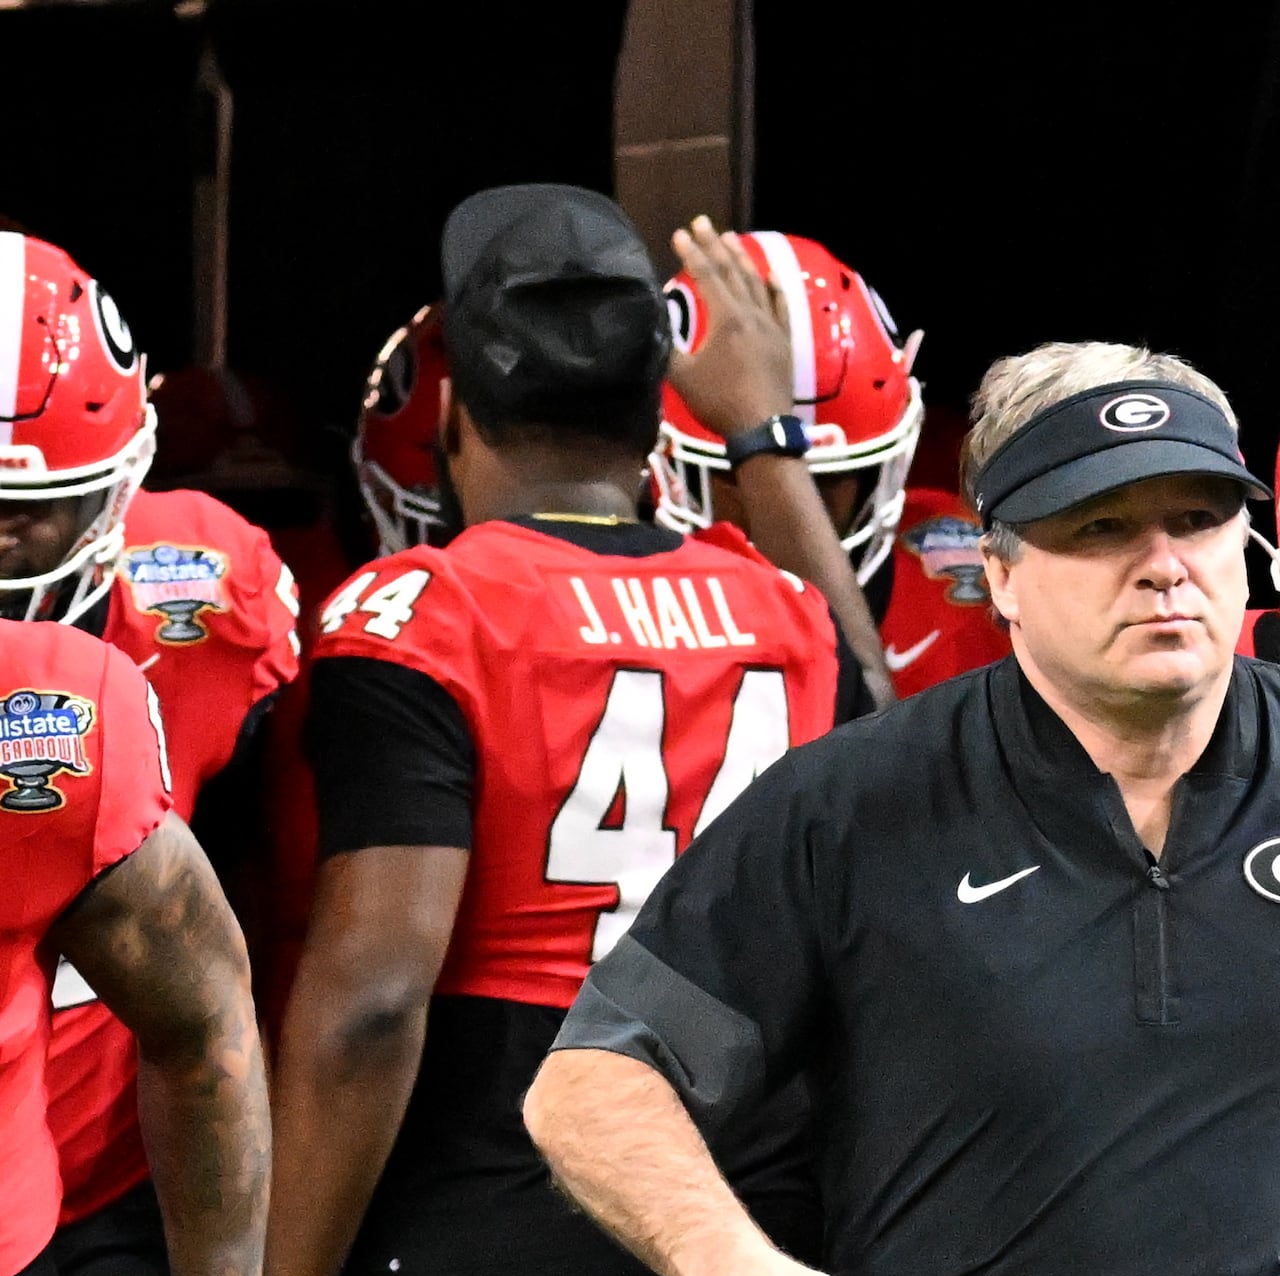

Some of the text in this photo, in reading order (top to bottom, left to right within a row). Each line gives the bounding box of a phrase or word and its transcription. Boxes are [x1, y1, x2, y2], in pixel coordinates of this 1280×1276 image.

[1100, 394, 1170, 432] G
[320, 568, 433, 642] 44
[570, 577, 757, 650] J. HALL
